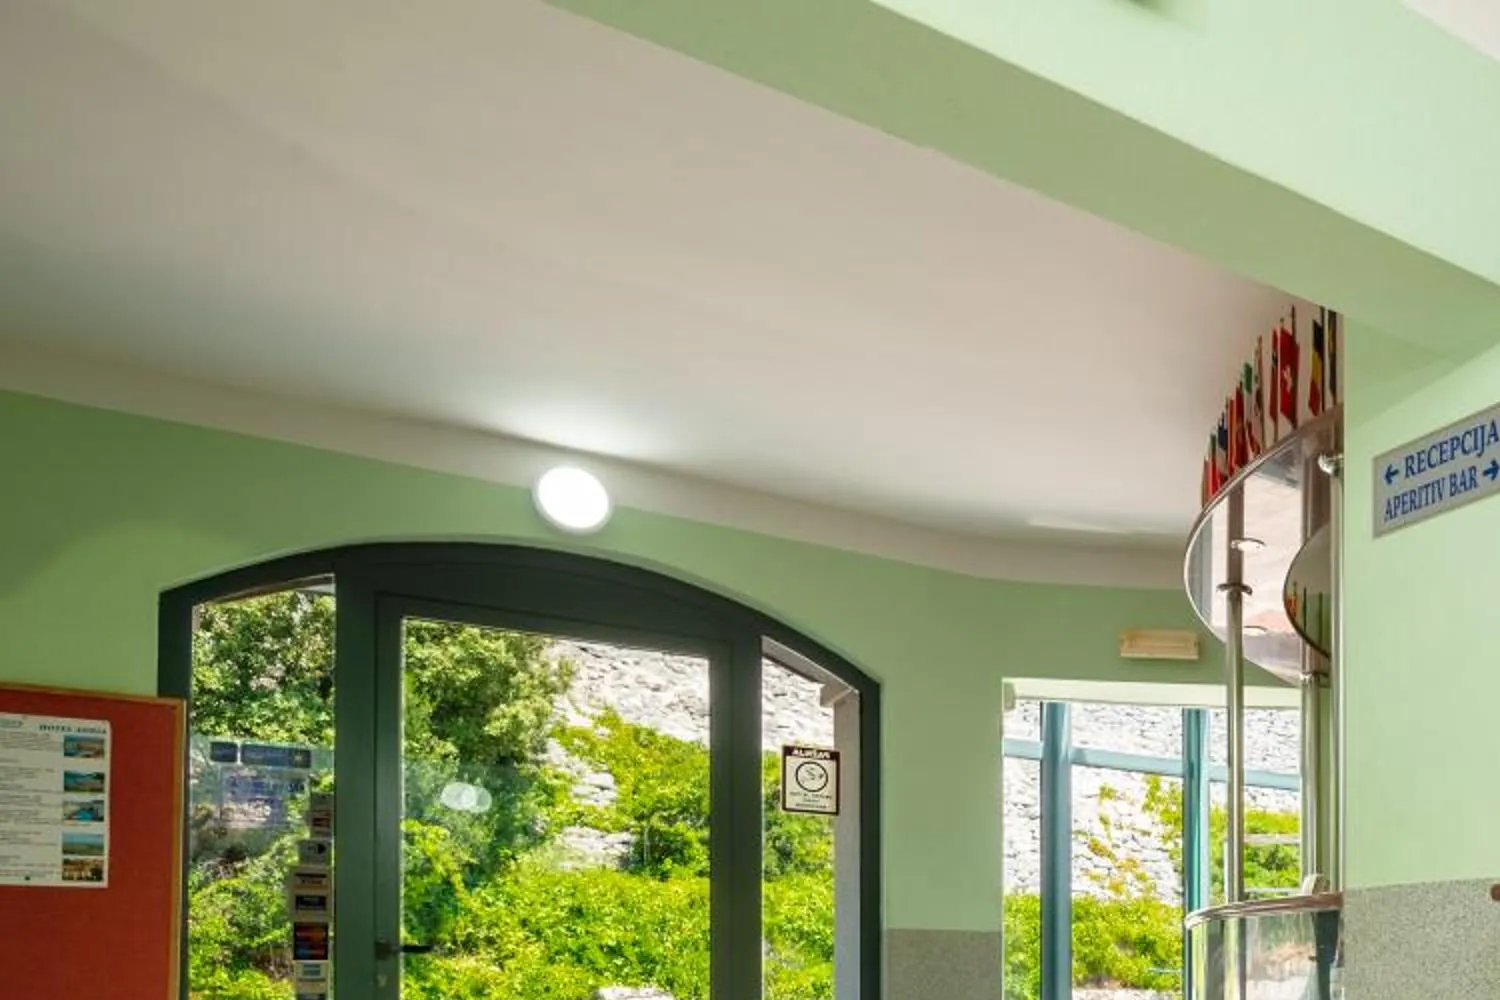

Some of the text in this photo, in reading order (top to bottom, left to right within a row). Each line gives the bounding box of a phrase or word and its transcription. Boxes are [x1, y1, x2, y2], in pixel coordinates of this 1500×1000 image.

[1404, 419, 1500, 479] RECEPCIJA
[1384, 465, 1479, 522] APERITIV BAR
